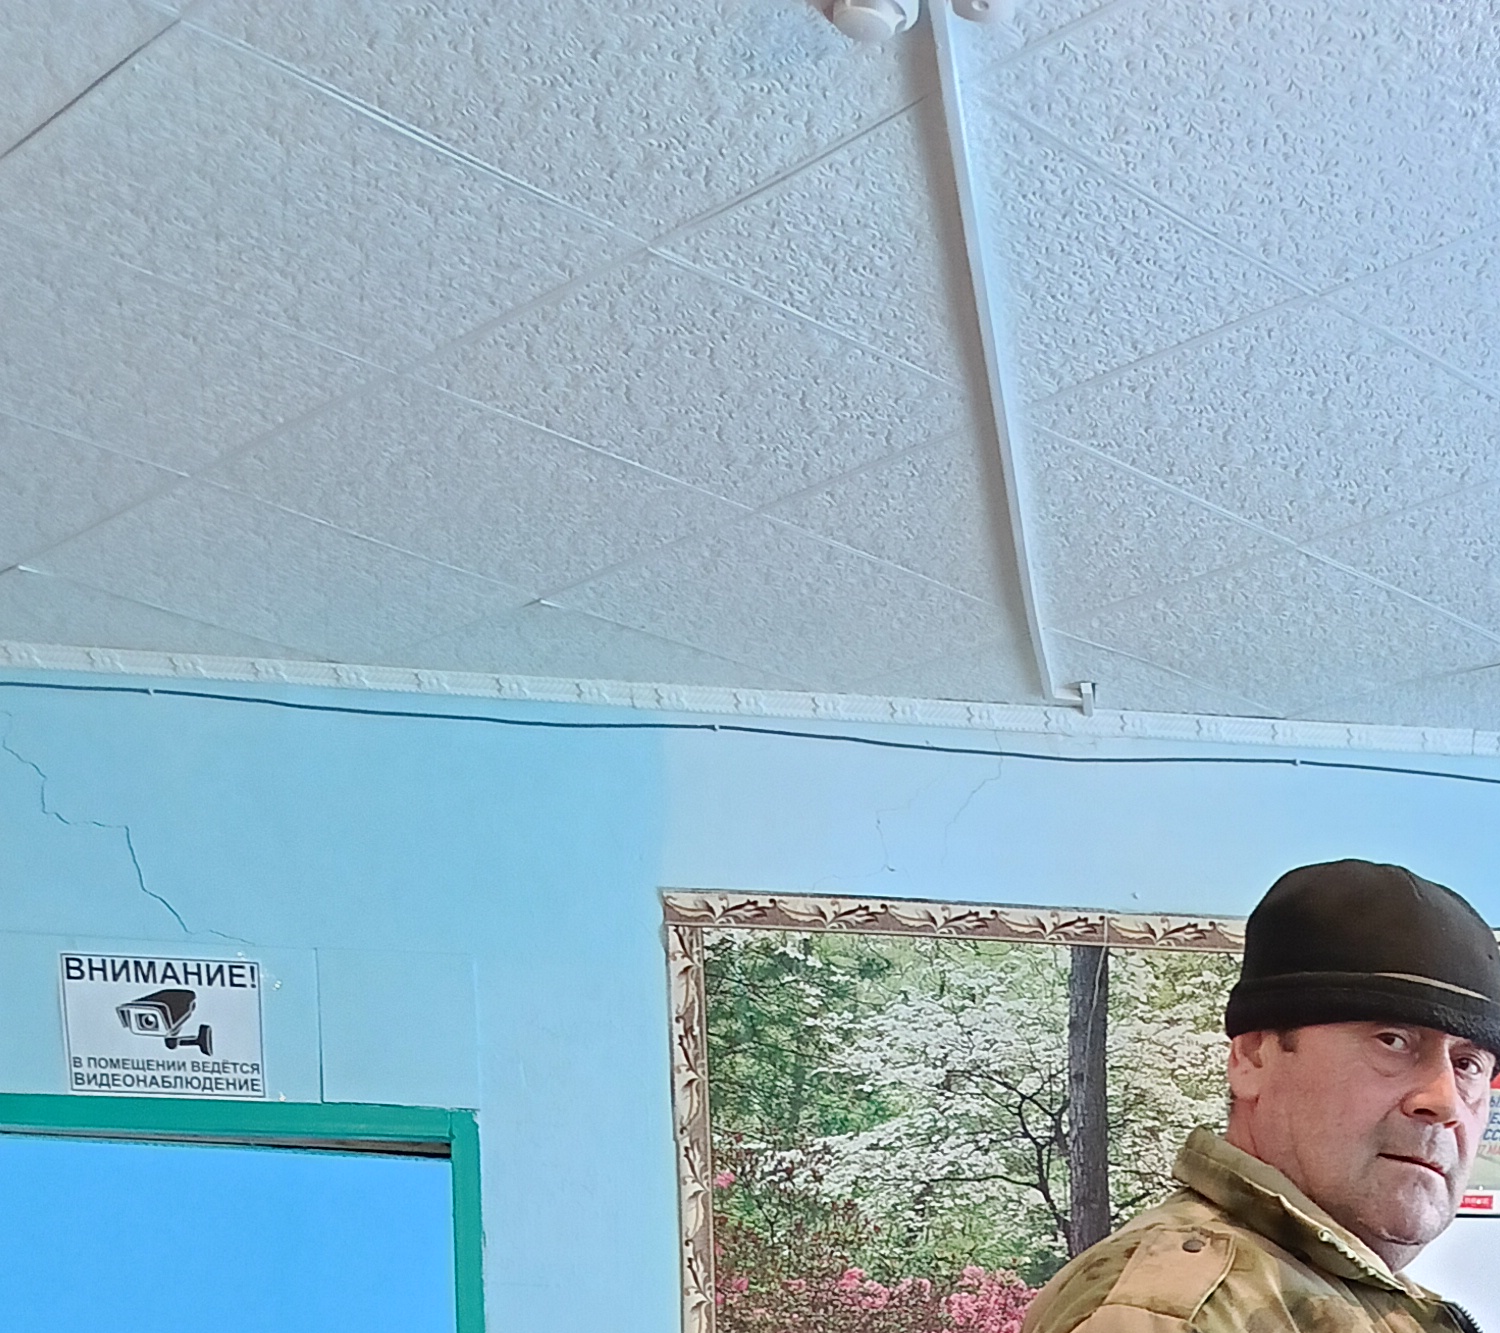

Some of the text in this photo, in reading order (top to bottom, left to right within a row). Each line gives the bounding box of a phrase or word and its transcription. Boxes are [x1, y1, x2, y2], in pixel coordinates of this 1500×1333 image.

[65, 957, 257, 988] ВНИМАНИЕ!
[73, 1057, 260, 1075] В ПОМЕЩЕНИИ ВЕДЁТСЯ
[74, 1073, 261, 1092] ВИДЕОНАБЛЮДЕНИЕ
